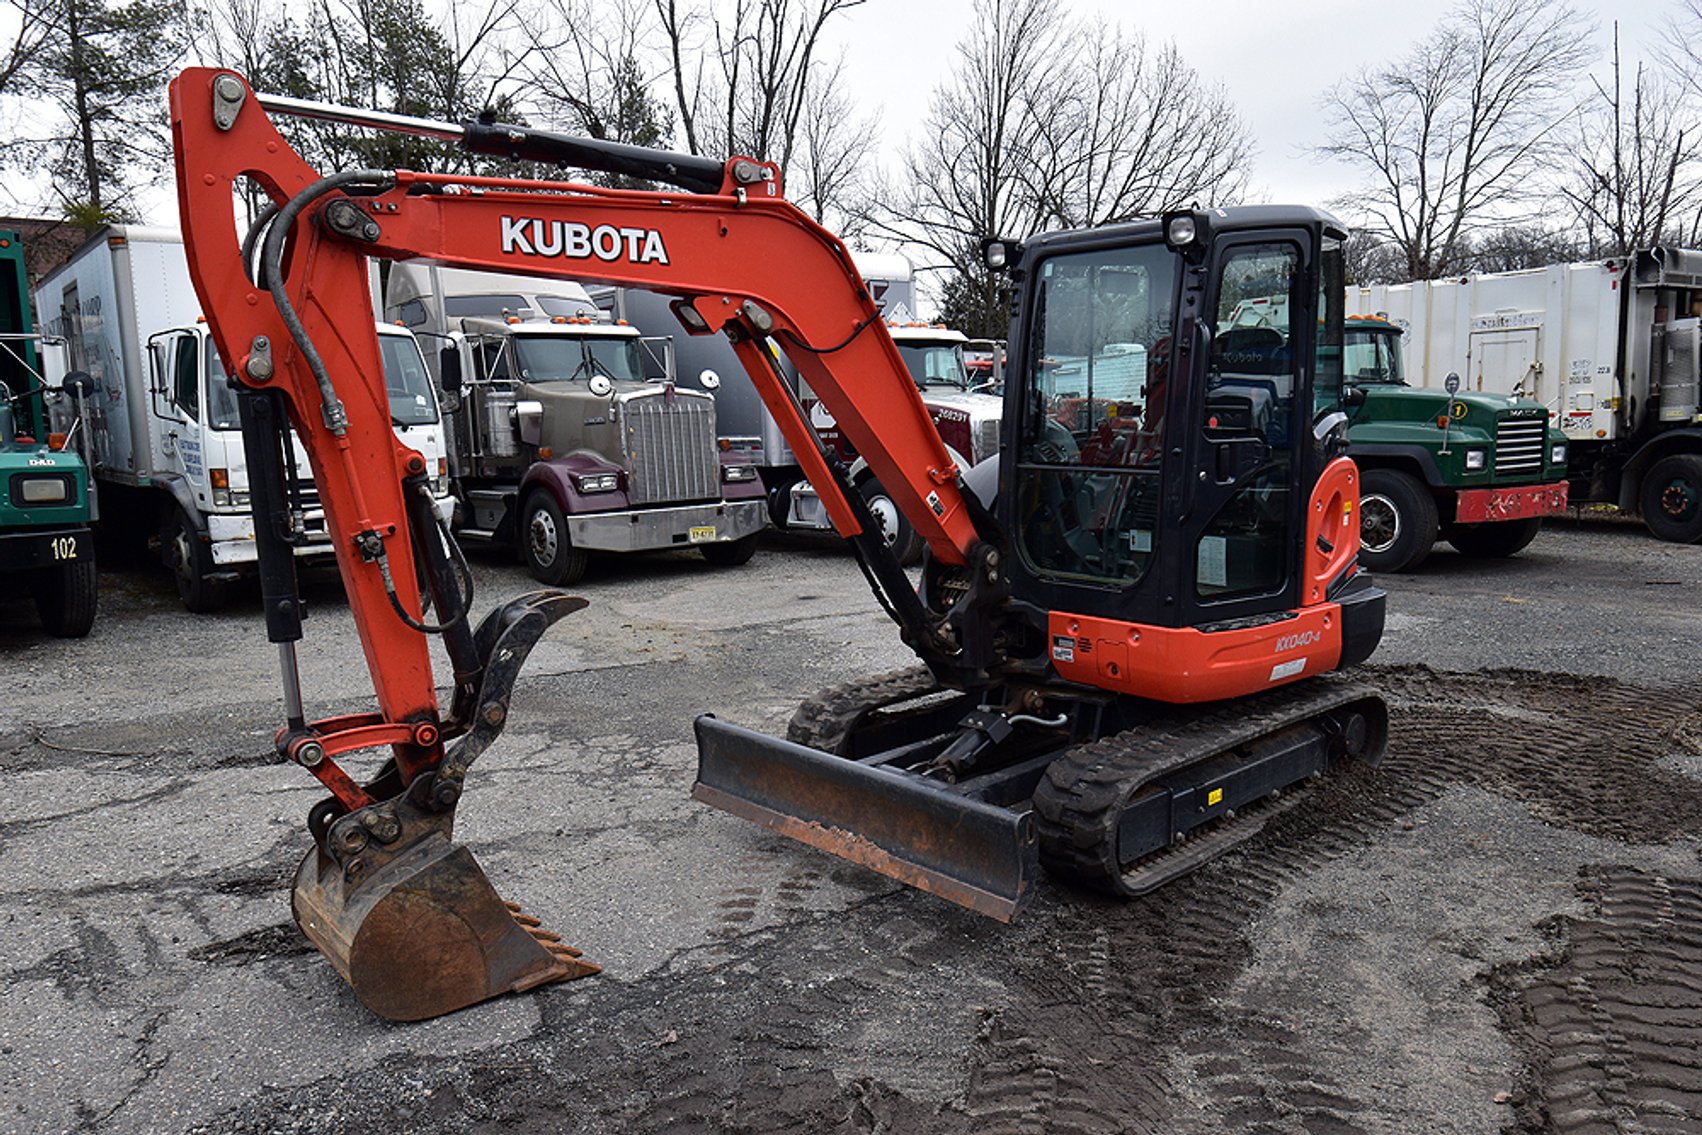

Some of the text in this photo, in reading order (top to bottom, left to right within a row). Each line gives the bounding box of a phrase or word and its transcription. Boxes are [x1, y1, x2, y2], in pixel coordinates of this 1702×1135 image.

[500, 216, 669, 264] KUBOTA
[1455, 405, 1462, 416] 1
[1509, 409, 1538, 417] MACK
[51, 537, 77, 560] 102
